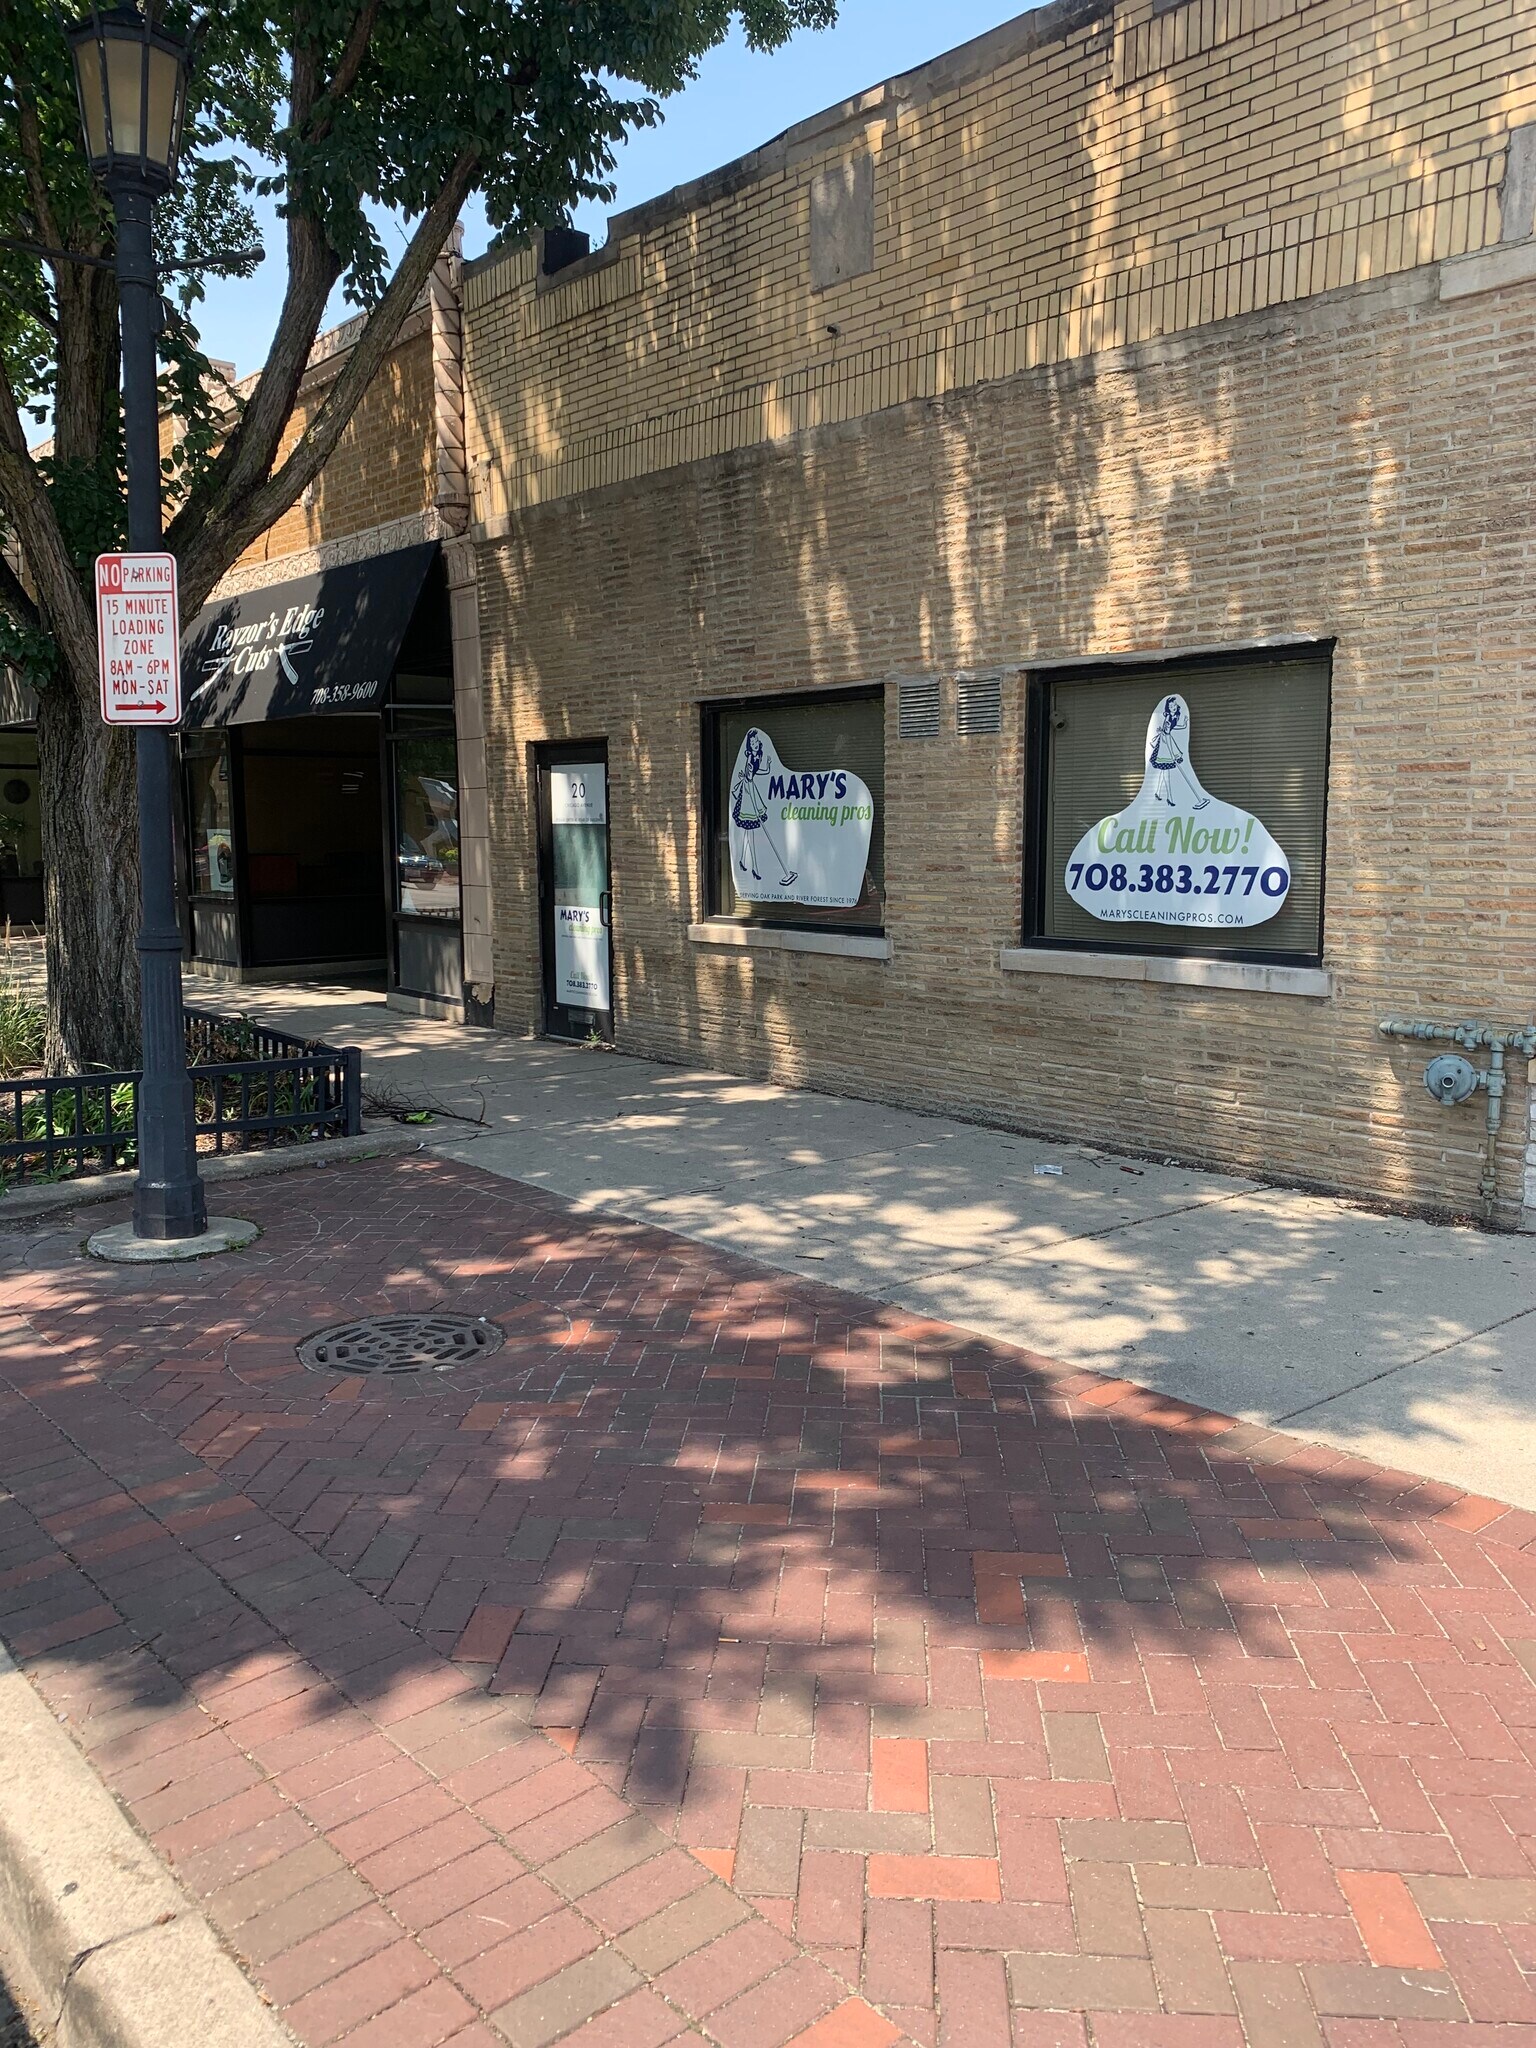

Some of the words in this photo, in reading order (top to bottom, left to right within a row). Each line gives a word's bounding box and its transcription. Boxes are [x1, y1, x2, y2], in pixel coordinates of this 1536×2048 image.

[100, 564, 120, 587] NO
[123, 567, 170, 583] PARKING
[106, 599, 119, 615] 15
[125, 599, 168, 615] MINUTE
[112, 619, 164, 635] LOADING
[209, 612, 279, 655] Rayzor's
[277, 604, 325, 638] Edge
[124, 640, 154, 655] ZONE
[110, 659, 133, 676] 8AM
[147, 659, 170, 675] 6PM
[233, 644, 273, 675] Cuts
[310, 680, 378, 706] 708-358-9600
[571, 782, 586, 798] 20
[768, 772, 847, 800] MARY'S
[781, 802, 838, 827] cleaning
[840, 804, 871, 826] pros
[1097, 817, 1157, 854] Call
[1165, 816, 1255, 855] Now!
[1069, 863, 1289, 897] 708.383.2770
[760, 892, 771, 900] OAK
[796, 894, 810, 902] RIVER
[811, 895, 830, 903] FOREST
[560, 909, 590, 923] MARY'S
[1100, 909, 1244, 924] MARYSCLEANINGPROS.COM
